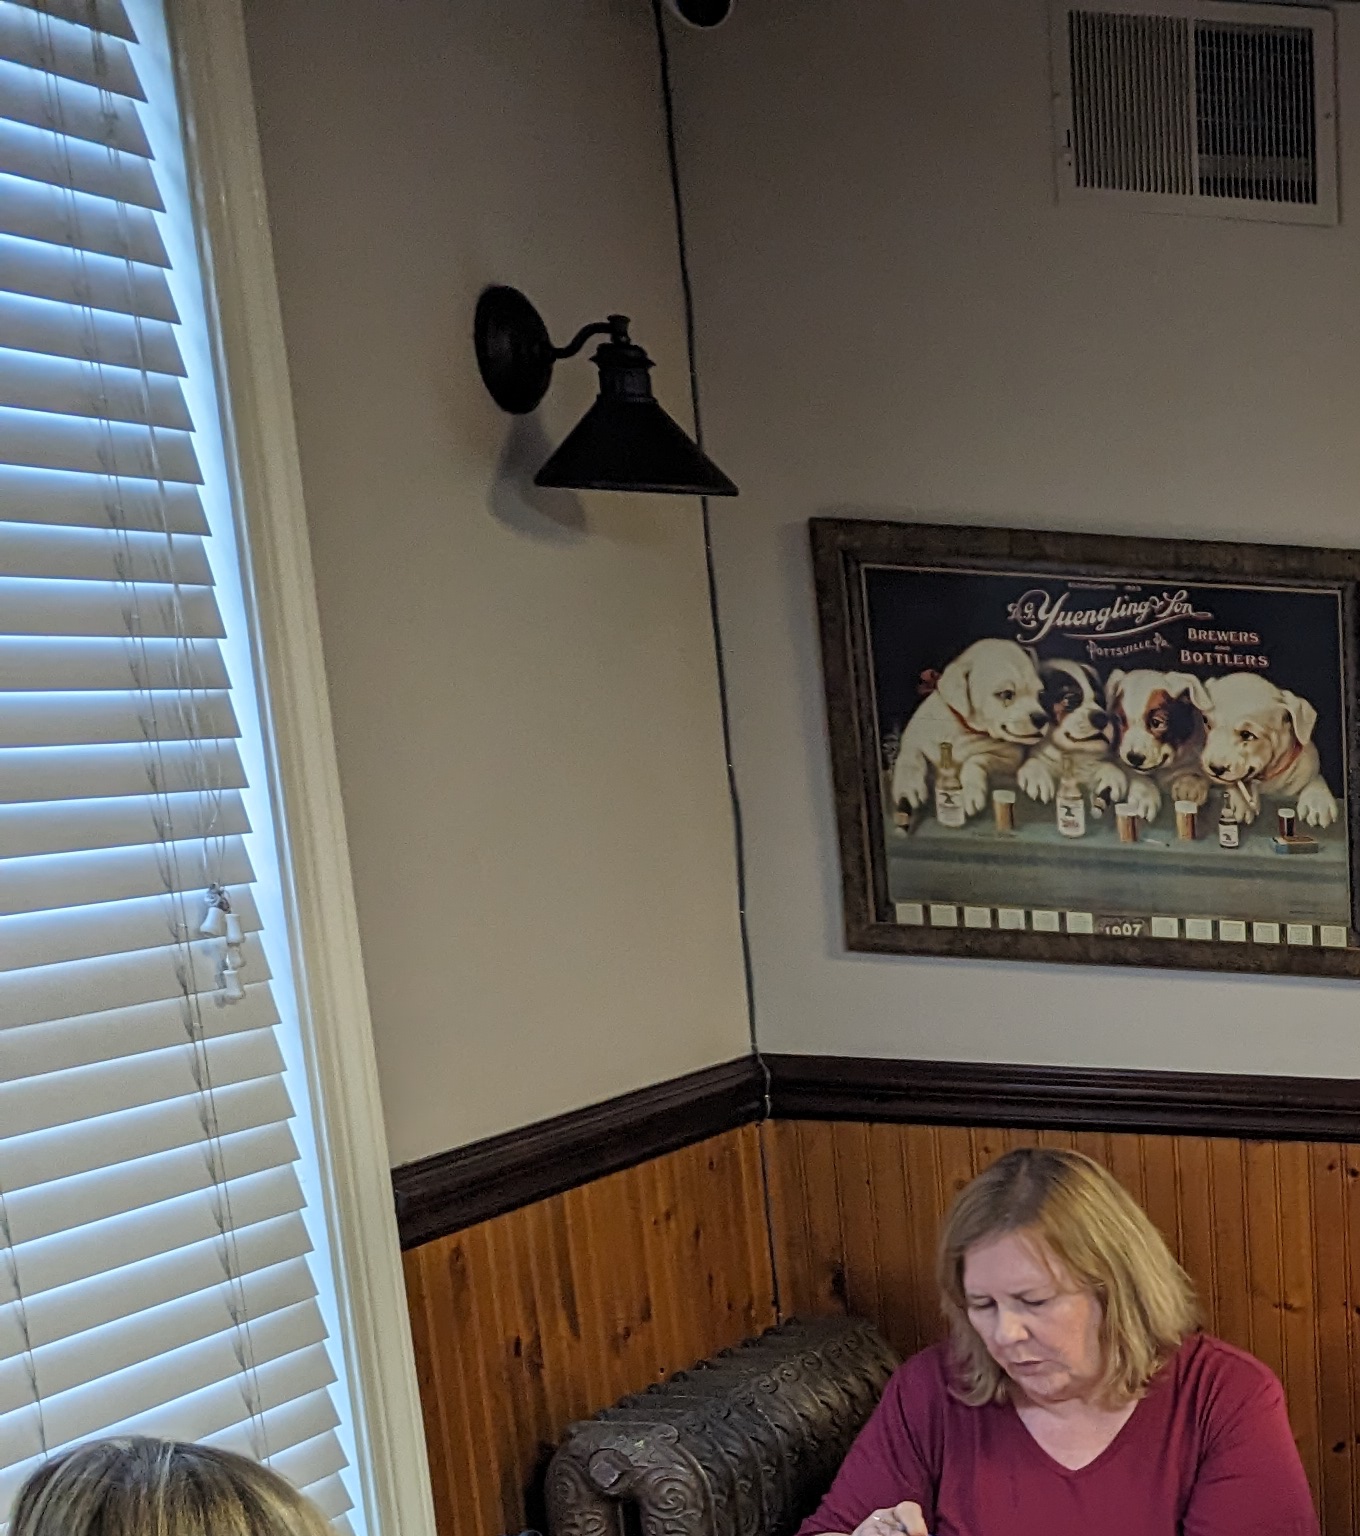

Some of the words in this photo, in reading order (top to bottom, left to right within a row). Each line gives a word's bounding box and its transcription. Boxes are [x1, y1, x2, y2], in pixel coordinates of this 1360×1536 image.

[1016, 590, 1152, 642] Yuengling
[1157, 589, 1209, 618] Son
[1187, 627, 1260, 644] BREWERS
[1180, 649, 1270, 668] BOTTLERS
